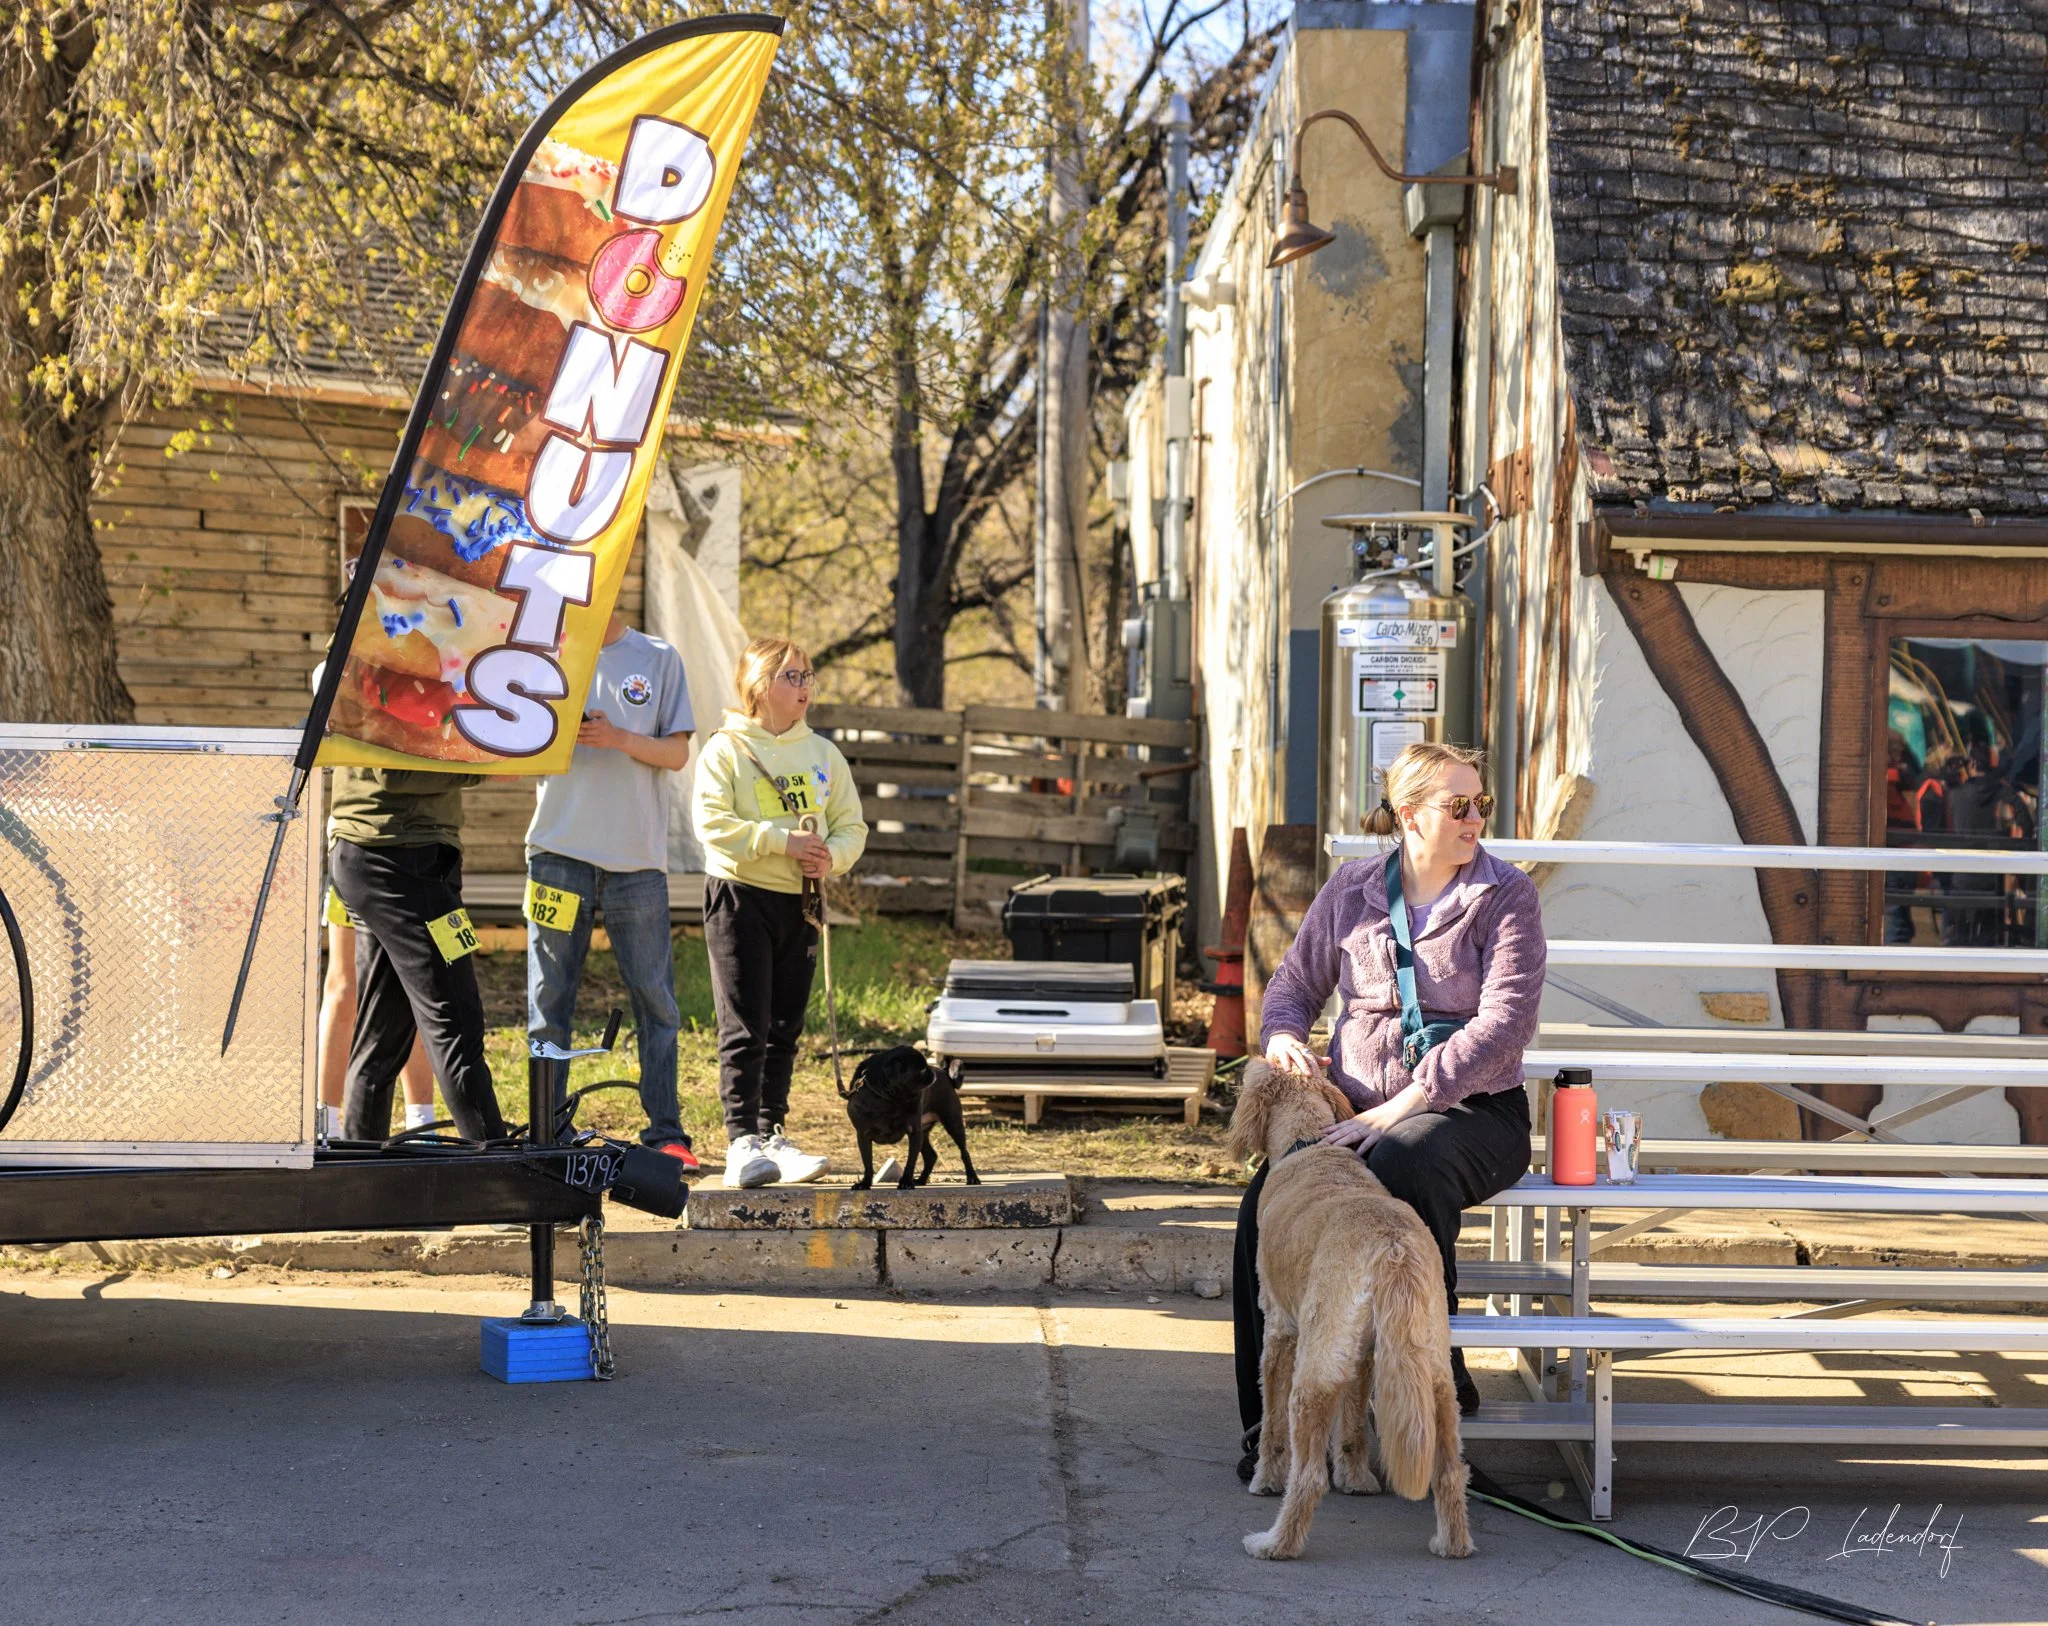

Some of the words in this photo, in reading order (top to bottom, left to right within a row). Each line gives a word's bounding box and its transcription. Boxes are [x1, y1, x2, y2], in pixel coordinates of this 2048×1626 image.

[452, 114, 717, 757] DONUTS
[1376, 621, 1433, 637] Carbo-Mizer
[1415, 636, 1433, 646] 450
[1370, 656, 1399, 664] CARBON
[1400, 656, 1428, 664] DIOXIDE
[791, 775, 806, 787] 5K
[549, 891, 563, 903] 5K
[531, 902, 558, 924] 182
[565, 1154, 622, 1188] 113796
